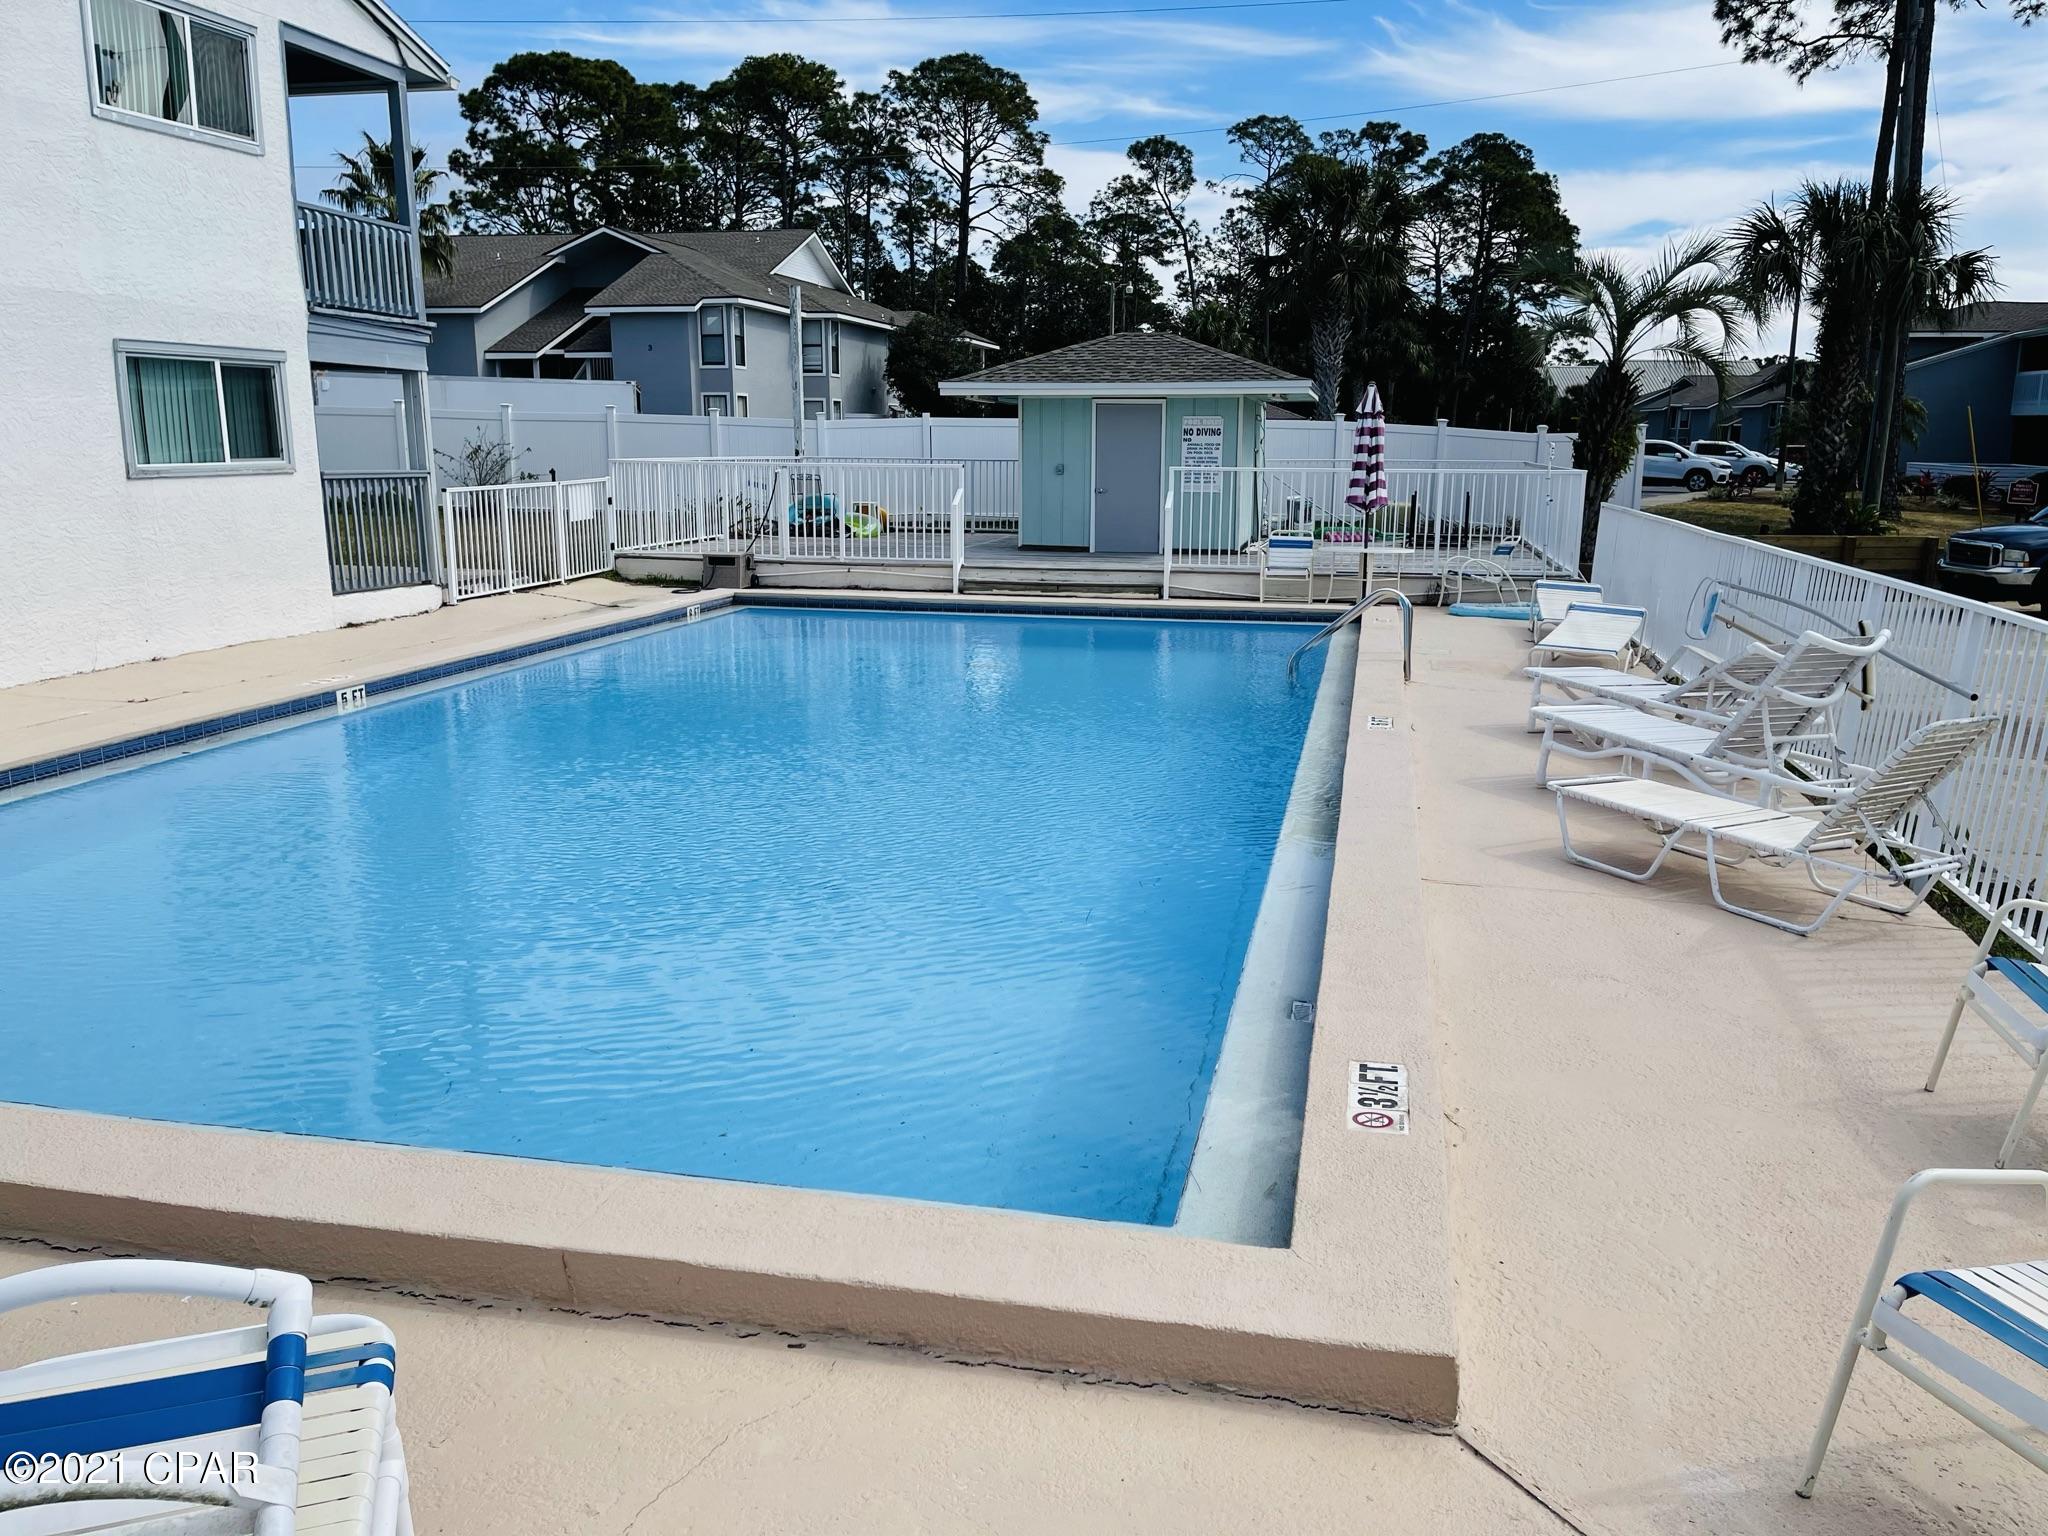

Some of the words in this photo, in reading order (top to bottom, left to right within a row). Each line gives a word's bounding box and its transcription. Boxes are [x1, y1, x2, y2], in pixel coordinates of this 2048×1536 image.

[1183, 428, 1194, 436] NO
[1196, 428, 1222, 436] DIVING
[341, 692, 348, 703] 5
[352, 688, 364, 701] FT
